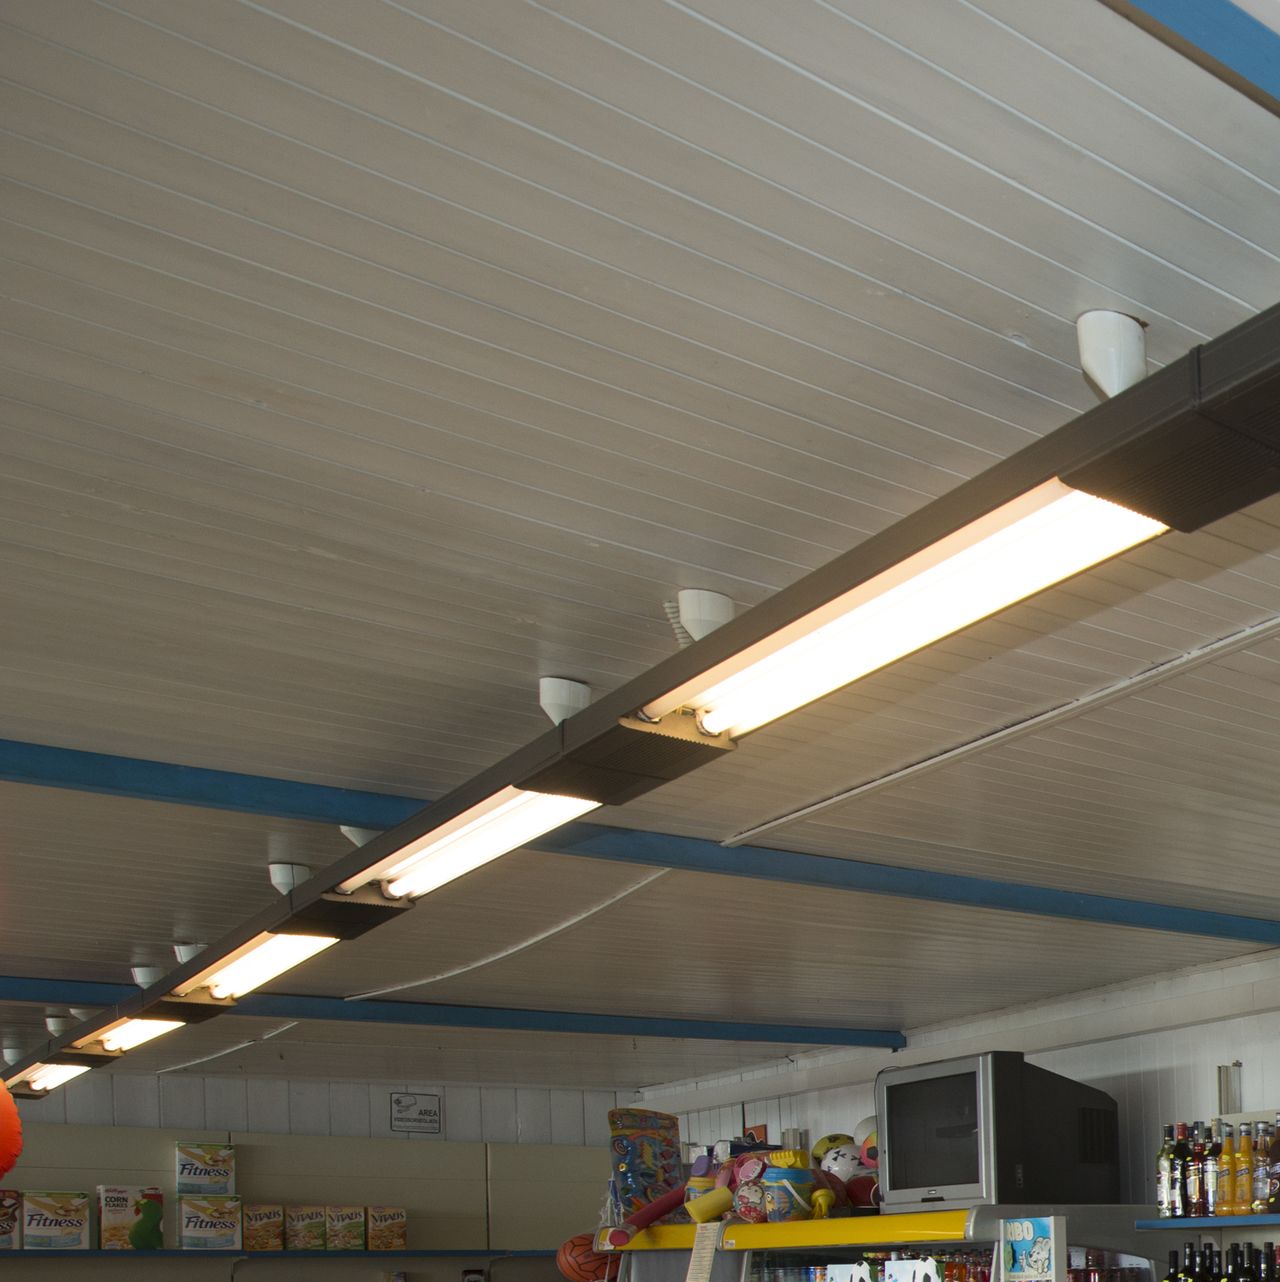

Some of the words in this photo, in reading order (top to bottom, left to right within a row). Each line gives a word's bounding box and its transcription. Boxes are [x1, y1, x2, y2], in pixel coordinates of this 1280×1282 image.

[418, 1109, 438, 1117] AREA
[180, 1164, 230, 1178] Fitness
[105, 1196, 128, 1204] CORN
[27, 1213, 84, 1228] Fitness
[245, 1210, 280, 1221] VITALIS
[288, 1210, 323, 1221] VITALIS
[328, 1210, 364, 1221] VITALIS
[371, 1210, 404, 1221] VITALIS
[185, 1214, 236, 1229] Fitness
